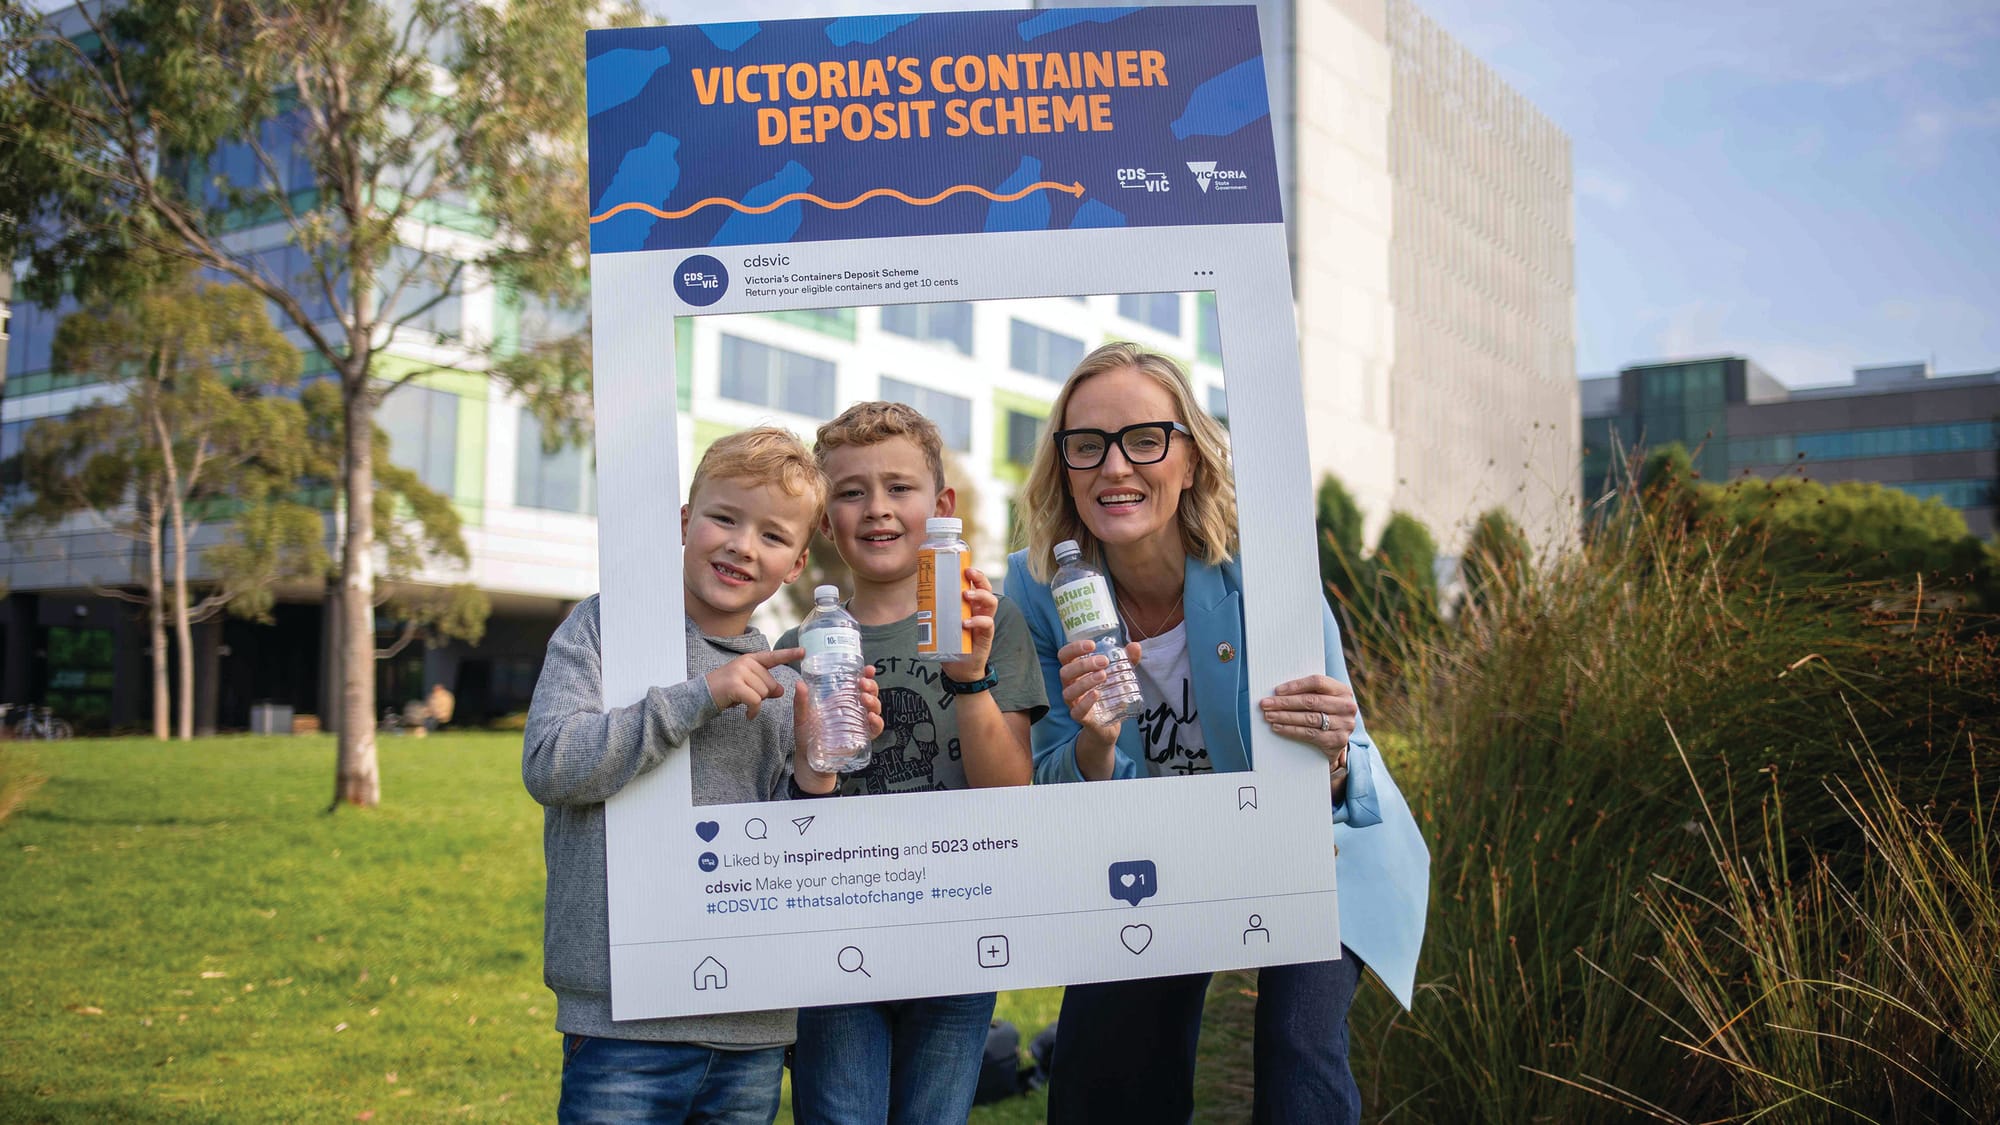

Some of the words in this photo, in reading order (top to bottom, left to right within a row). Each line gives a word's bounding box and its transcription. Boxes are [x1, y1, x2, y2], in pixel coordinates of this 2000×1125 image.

[691, 56, 923, 106] VICTORIA'S
[930, 50, 1168, 94] CONTAINER
[757, 100, 936, 146] DEPOSIT
[945, 94, 1114, 138] SCHEME
[1117, 168, 1146, 181] CDS
[1193, 170, 1247, 180] VICTORIA
[1145, 180, 1170, 193] VIC
[743, 254, 791, 268] cdsvic
[683, 272, 703, 283] CDS
[702, 279, 719, 289] VIC
[745, 274, 789, 286] Victoria's
[791, 272, 842, 283] Containers
[844, 269, 880, 281] Deposit
[882, 267, 919, 278] Scheme
[745, 287, 776, 297] Return
[778, 287, 799, 297] your
[801, 283, 833, 295] eligible
[835, 281, 882, 292] containers
[884, 280, 901, 290] and
[903, 279, 919, 290] get
[920, 278, 932, 288] 10
[933, 277, 959, 287] cents
[1064, 610, 1100, 631] Water
[723, 852, 760, 868] Liked
[764, 852, 781, 869] by
[784, 844, 900, 865] inspiredprinting
[903, 842, 928, 856] and
[931, 838, 969, 854] 5023
[972, 836, 1019, 852] others
[705, 880, 752, 895] cdsvic
[755, 876, 792, 891] Make
[796, 875, 828, 892] your
[831, 871, 882, 888] change
[884, 867, 927, 884] today!
[1138, 873, 1145, 886] 1
[706, 897, 778, 915] #CDSVIC
[786, 888, 924, 910] #thatsalotofchange
[931, 883, 993, 900] #recycle
